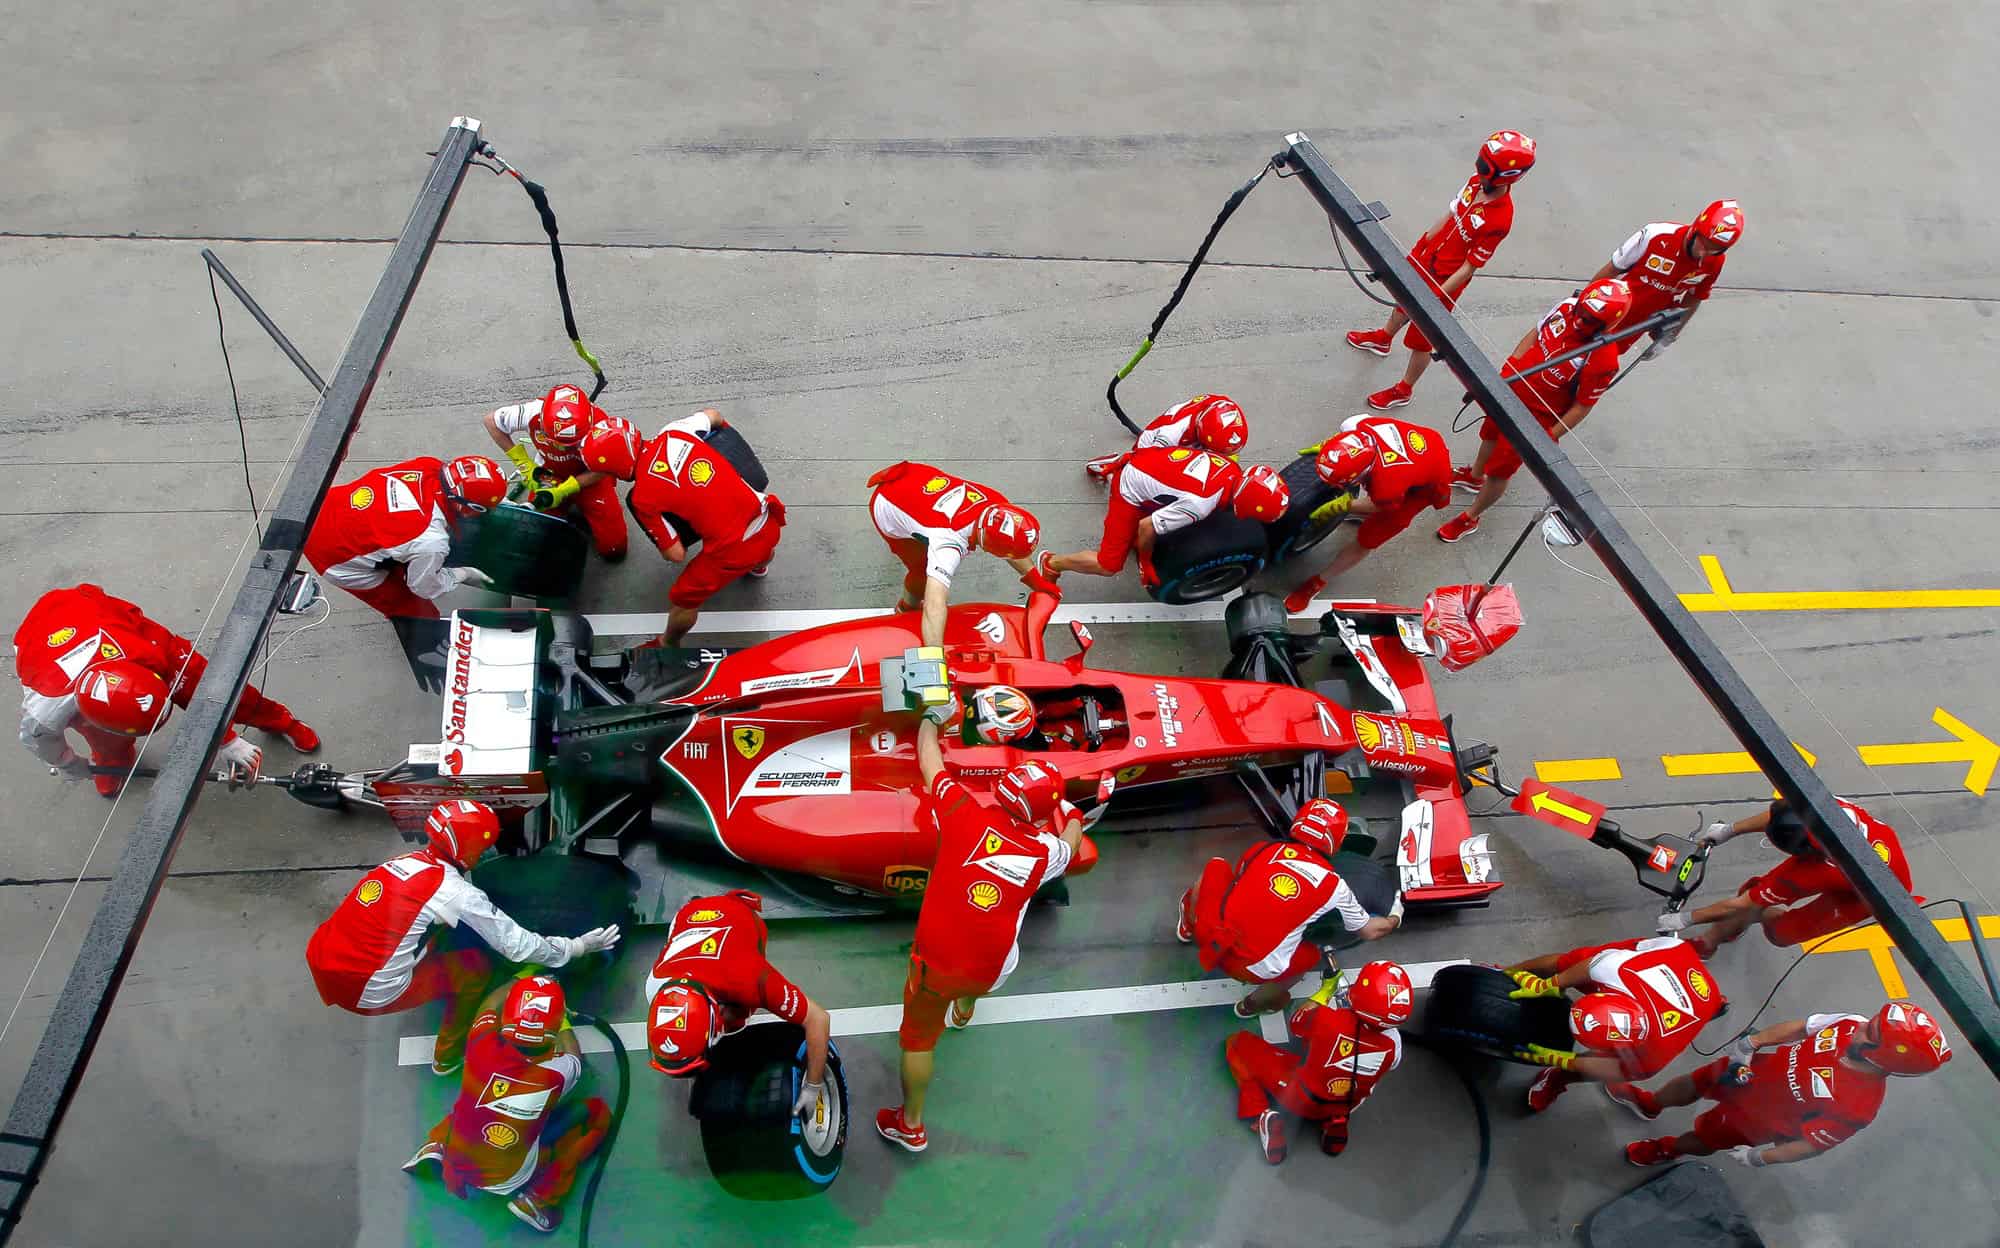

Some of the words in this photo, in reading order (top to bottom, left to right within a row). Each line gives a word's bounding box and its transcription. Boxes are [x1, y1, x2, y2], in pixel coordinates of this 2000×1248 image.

[446, 620, 475, 746] Santander
[1154, 683, 1178, 748] WEICHAI
[1315, 701, 1342, 737] 7
[684, 741, 710, 760] FIAT
[758, 771, 825, 781] SCUDERIA
[781, 779, 841, 789] FERRARI
[886, 875, 927, 892] ups
[1786, 1043, 1806, 1103] Santander
